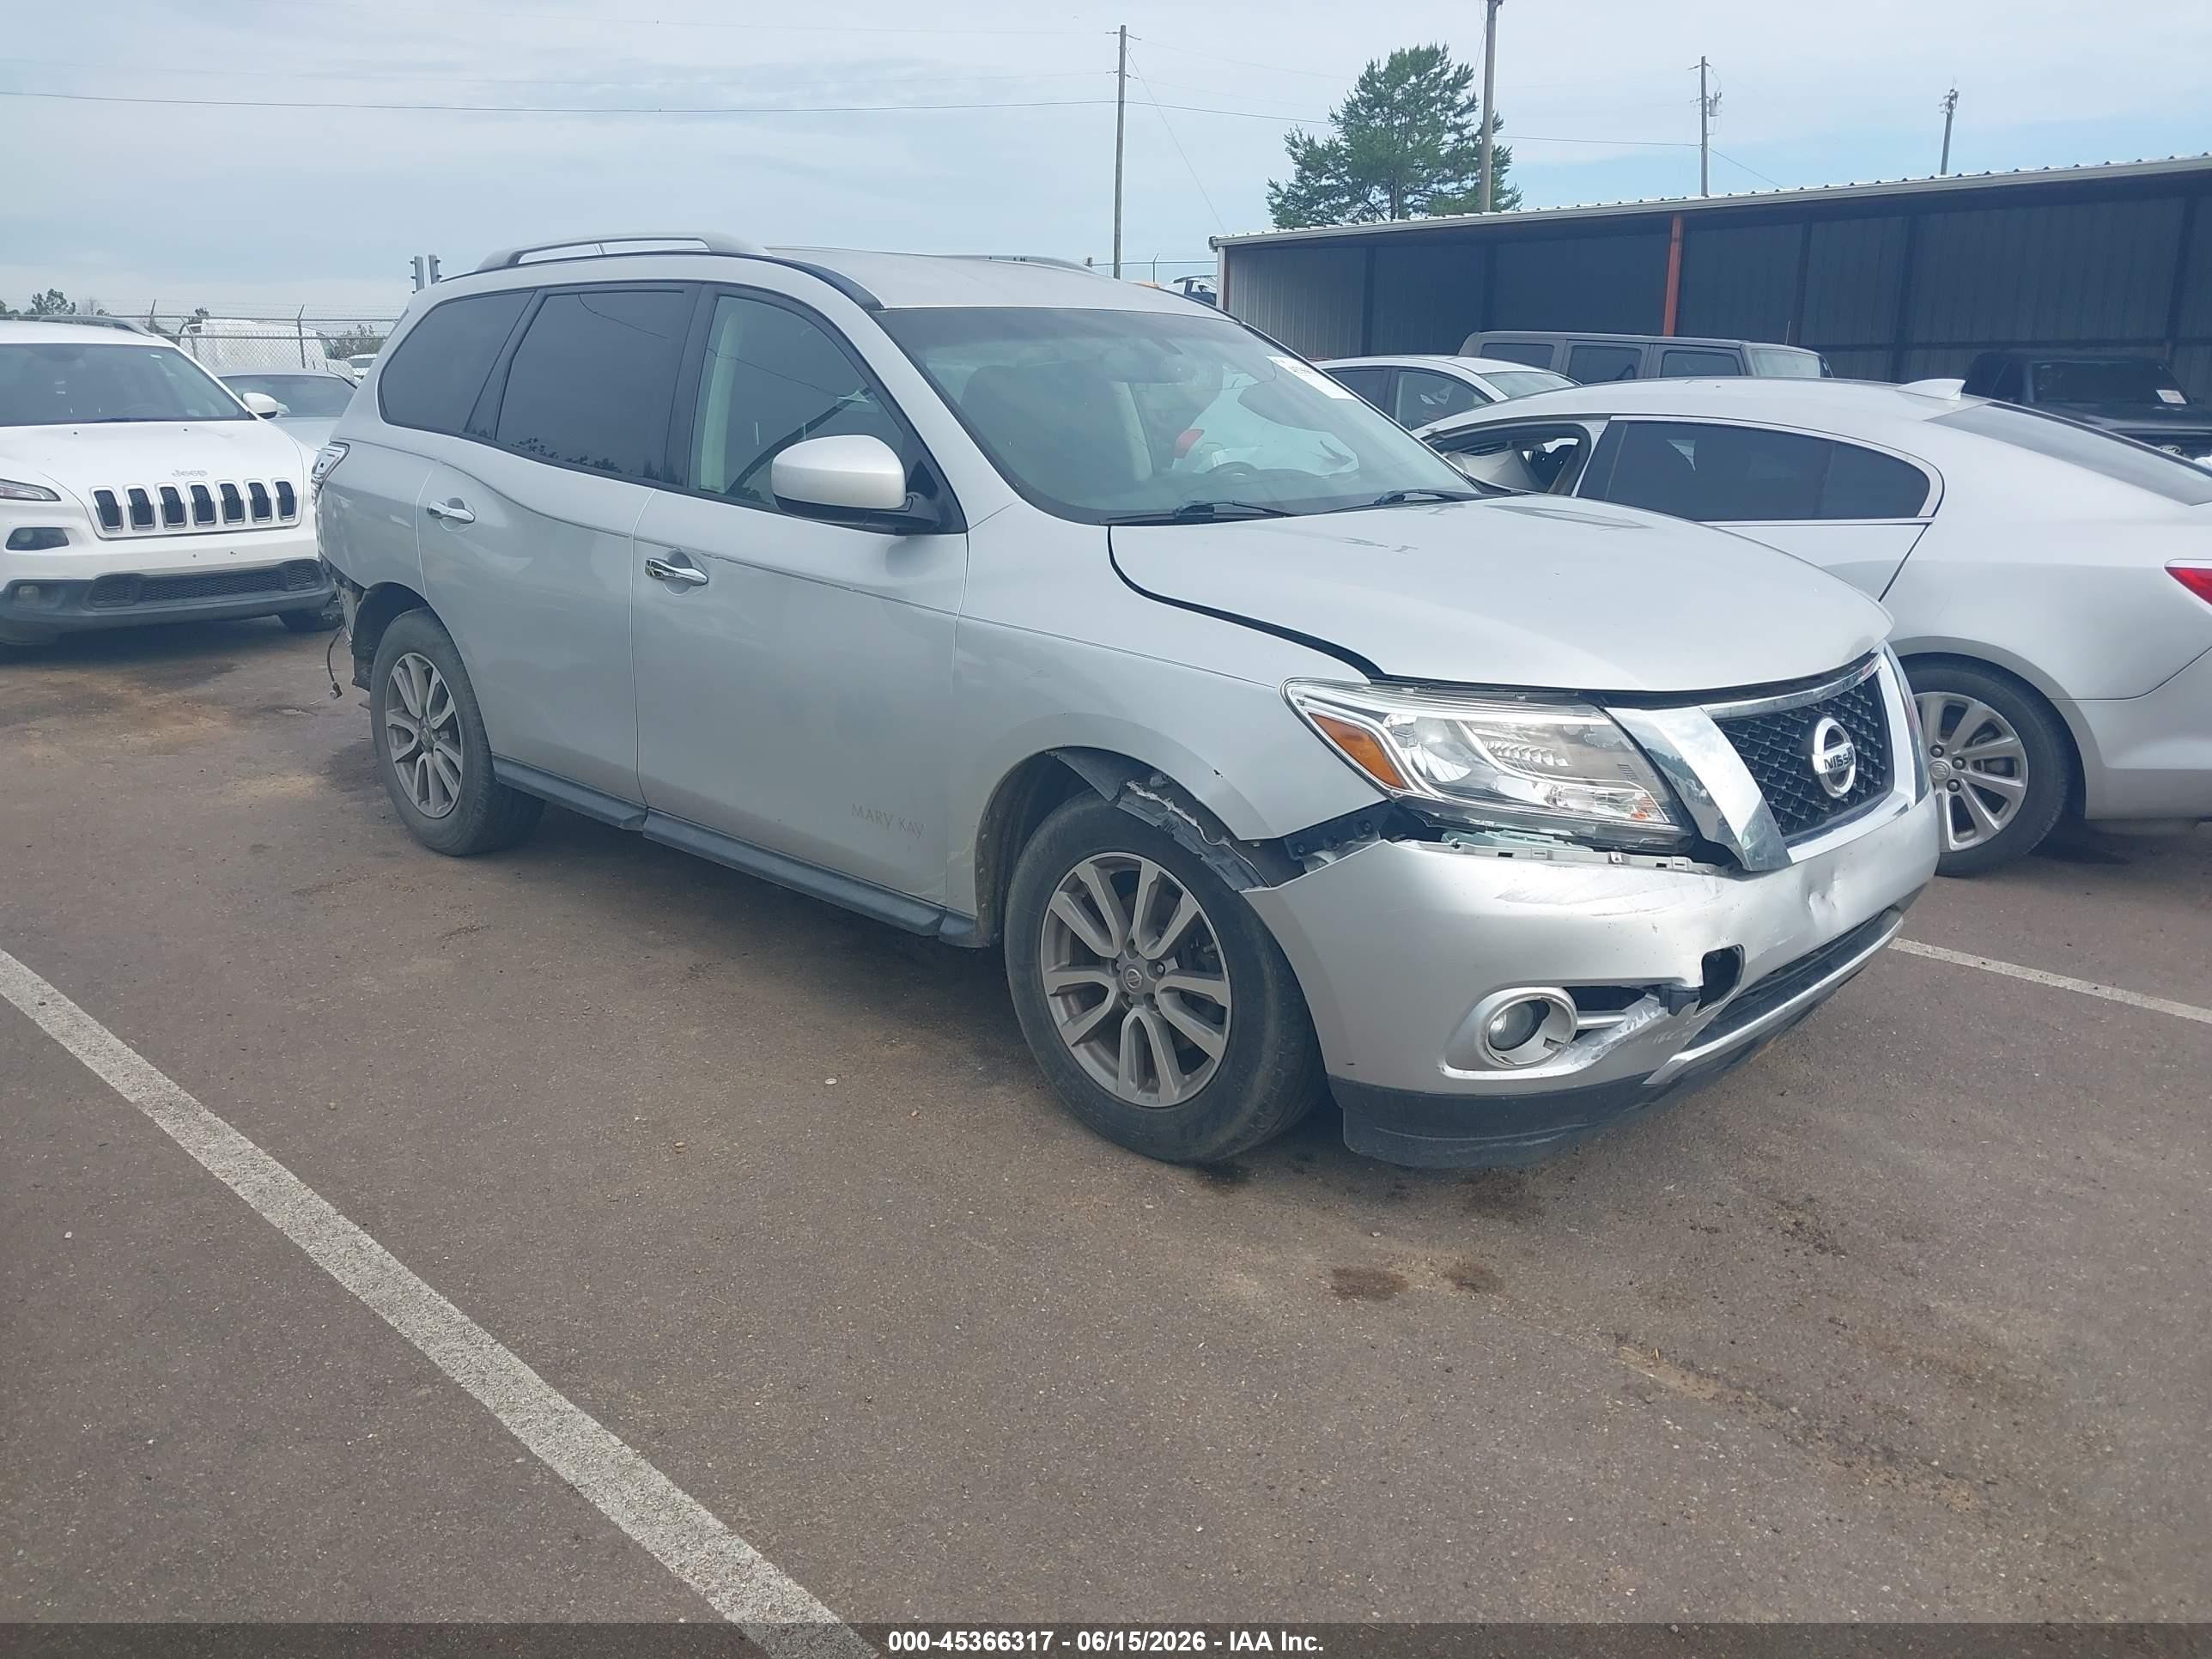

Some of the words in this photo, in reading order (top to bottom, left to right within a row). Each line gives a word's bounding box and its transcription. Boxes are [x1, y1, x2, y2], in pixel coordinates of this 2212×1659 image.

[1823, 750, 1855, 770] NISSA
[851, 803, 893, 830] MARY
[898, 817, 925, 839] KAY
